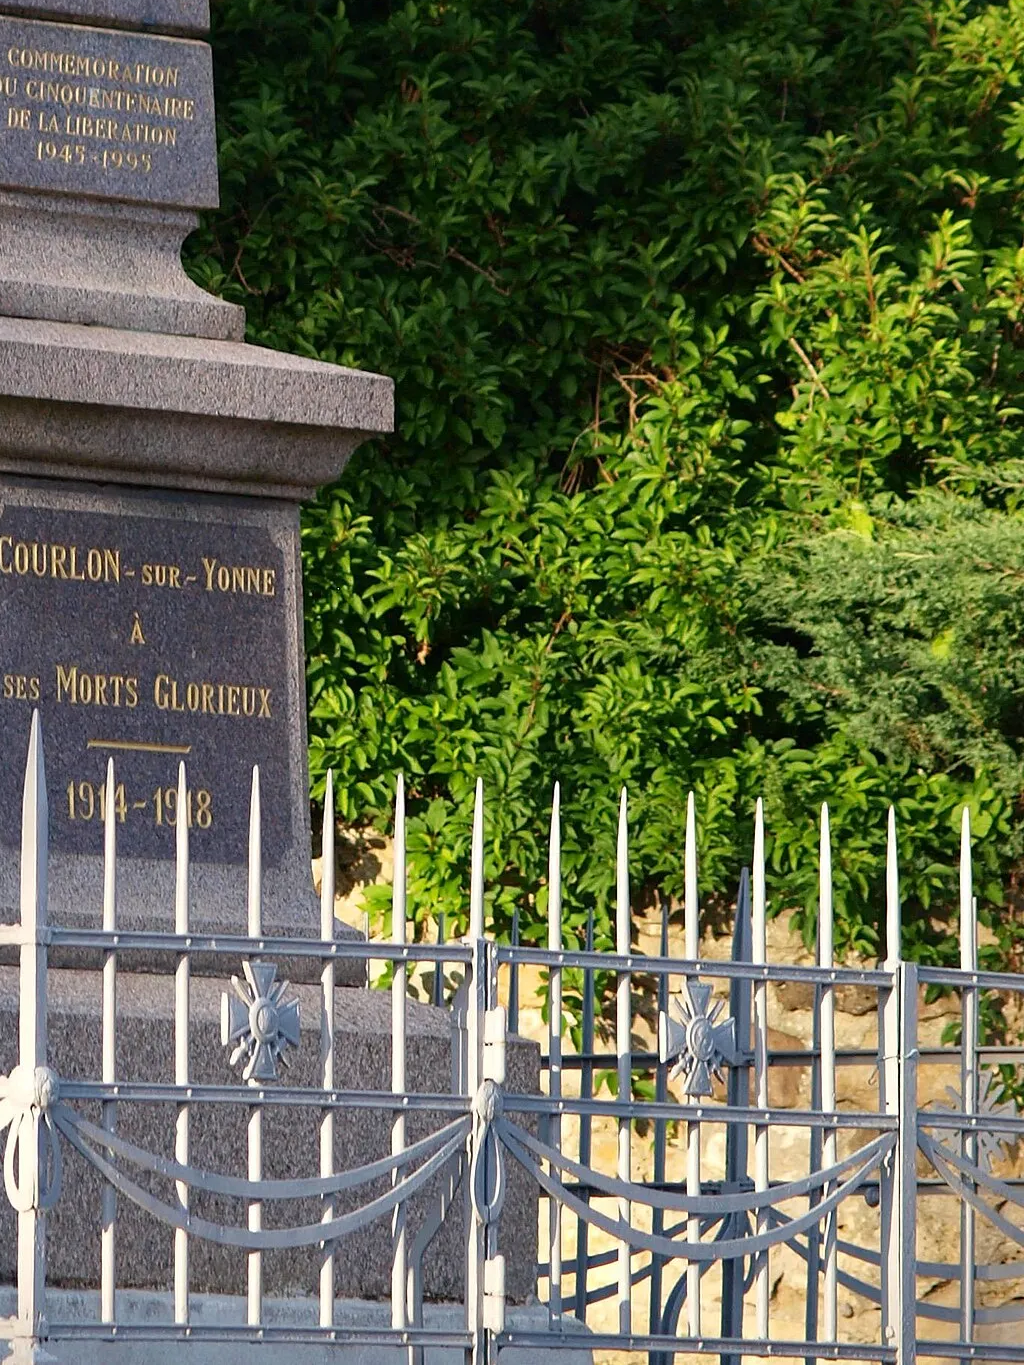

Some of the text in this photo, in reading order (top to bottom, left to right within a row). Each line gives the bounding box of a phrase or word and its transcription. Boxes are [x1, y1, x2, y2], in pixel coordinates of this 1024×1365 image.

[7, 107, 177, 146] DE LA LIBERATION
[4, 664, 272, 719] SES MORTS GLORIEUX
